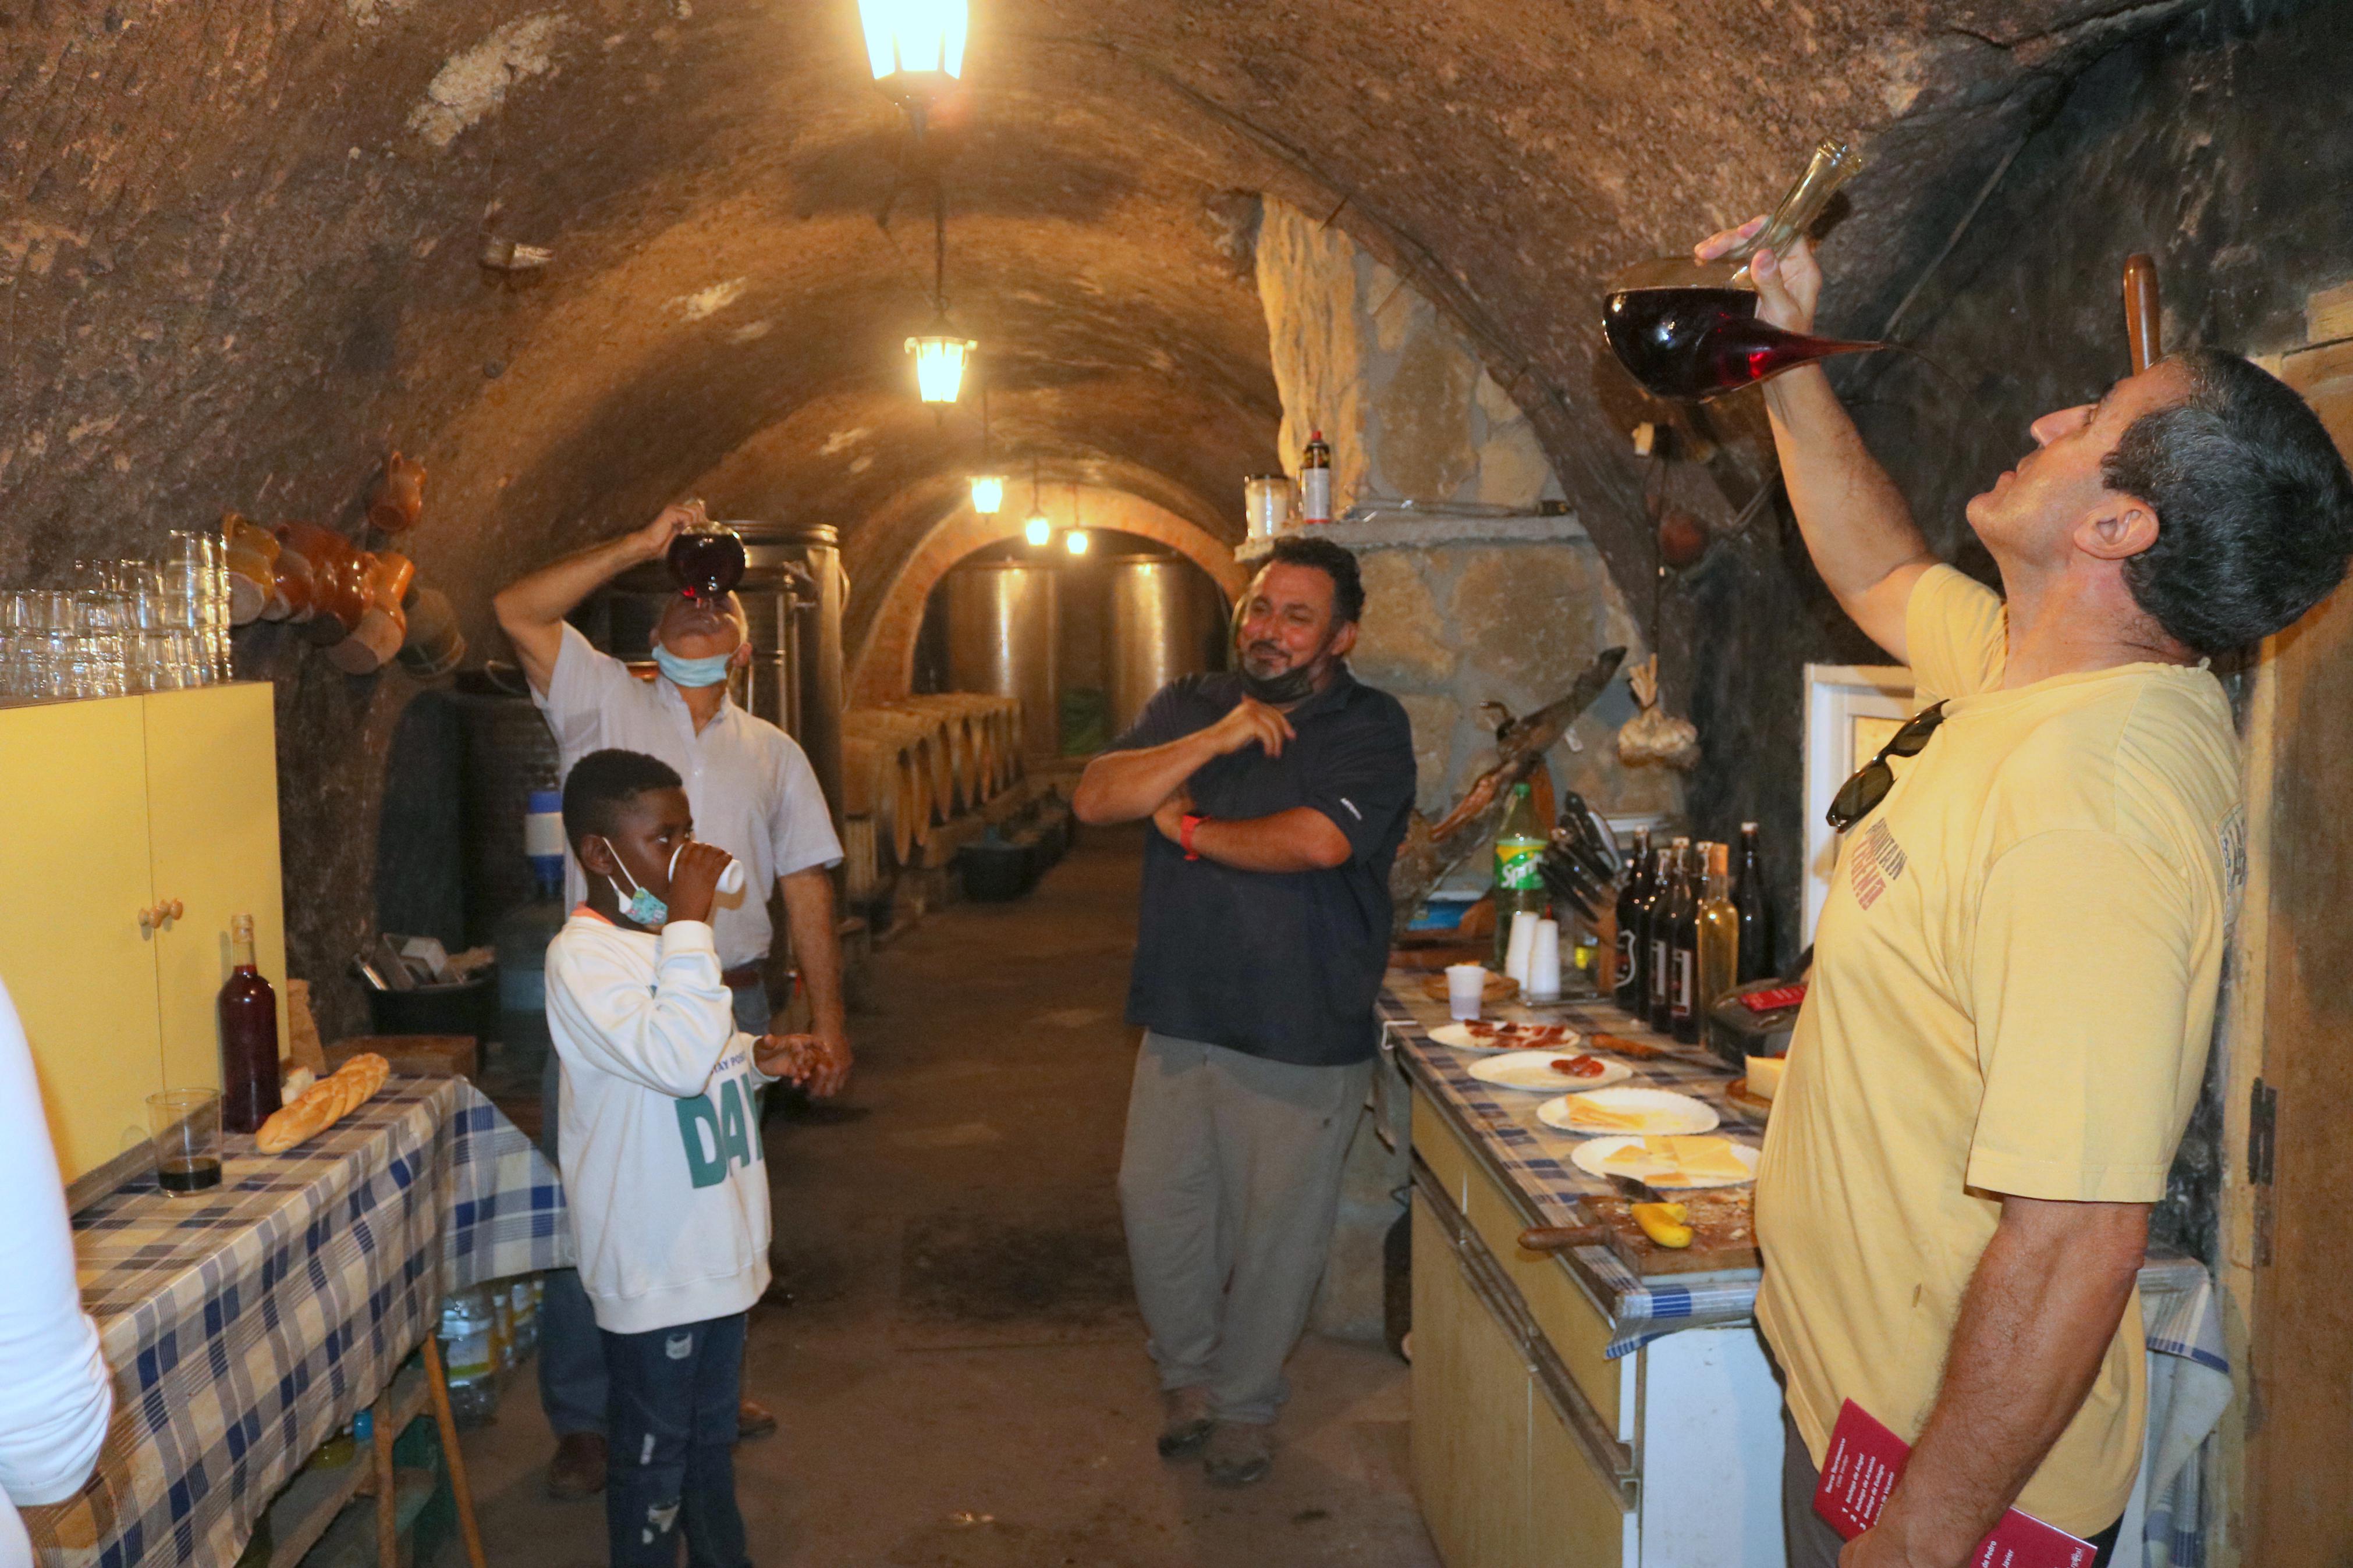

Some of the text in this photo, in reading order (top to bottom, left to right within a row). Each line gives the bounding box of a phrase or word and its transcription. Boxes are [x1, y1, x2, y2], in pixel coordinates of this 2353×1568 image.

[1854, 1453, 1864, 1472] Ángel
[1853, 1471, 1859, 1481] de
[1883, 1472, 1894, 1494] Vicente
[1846, 1480, 1857, 1503] Bodega
[1855, 1488, 1866, 1512] Bodega
[1863, 1480, 1869, 1489] de
[1864, 1496, 1875, 1519] Bodega
[1871, 1487, 1878, 1496] de
[1981, 1541, 1996, 1568] de Pedro
[2001, 1549, 2014, 1568] Javier
